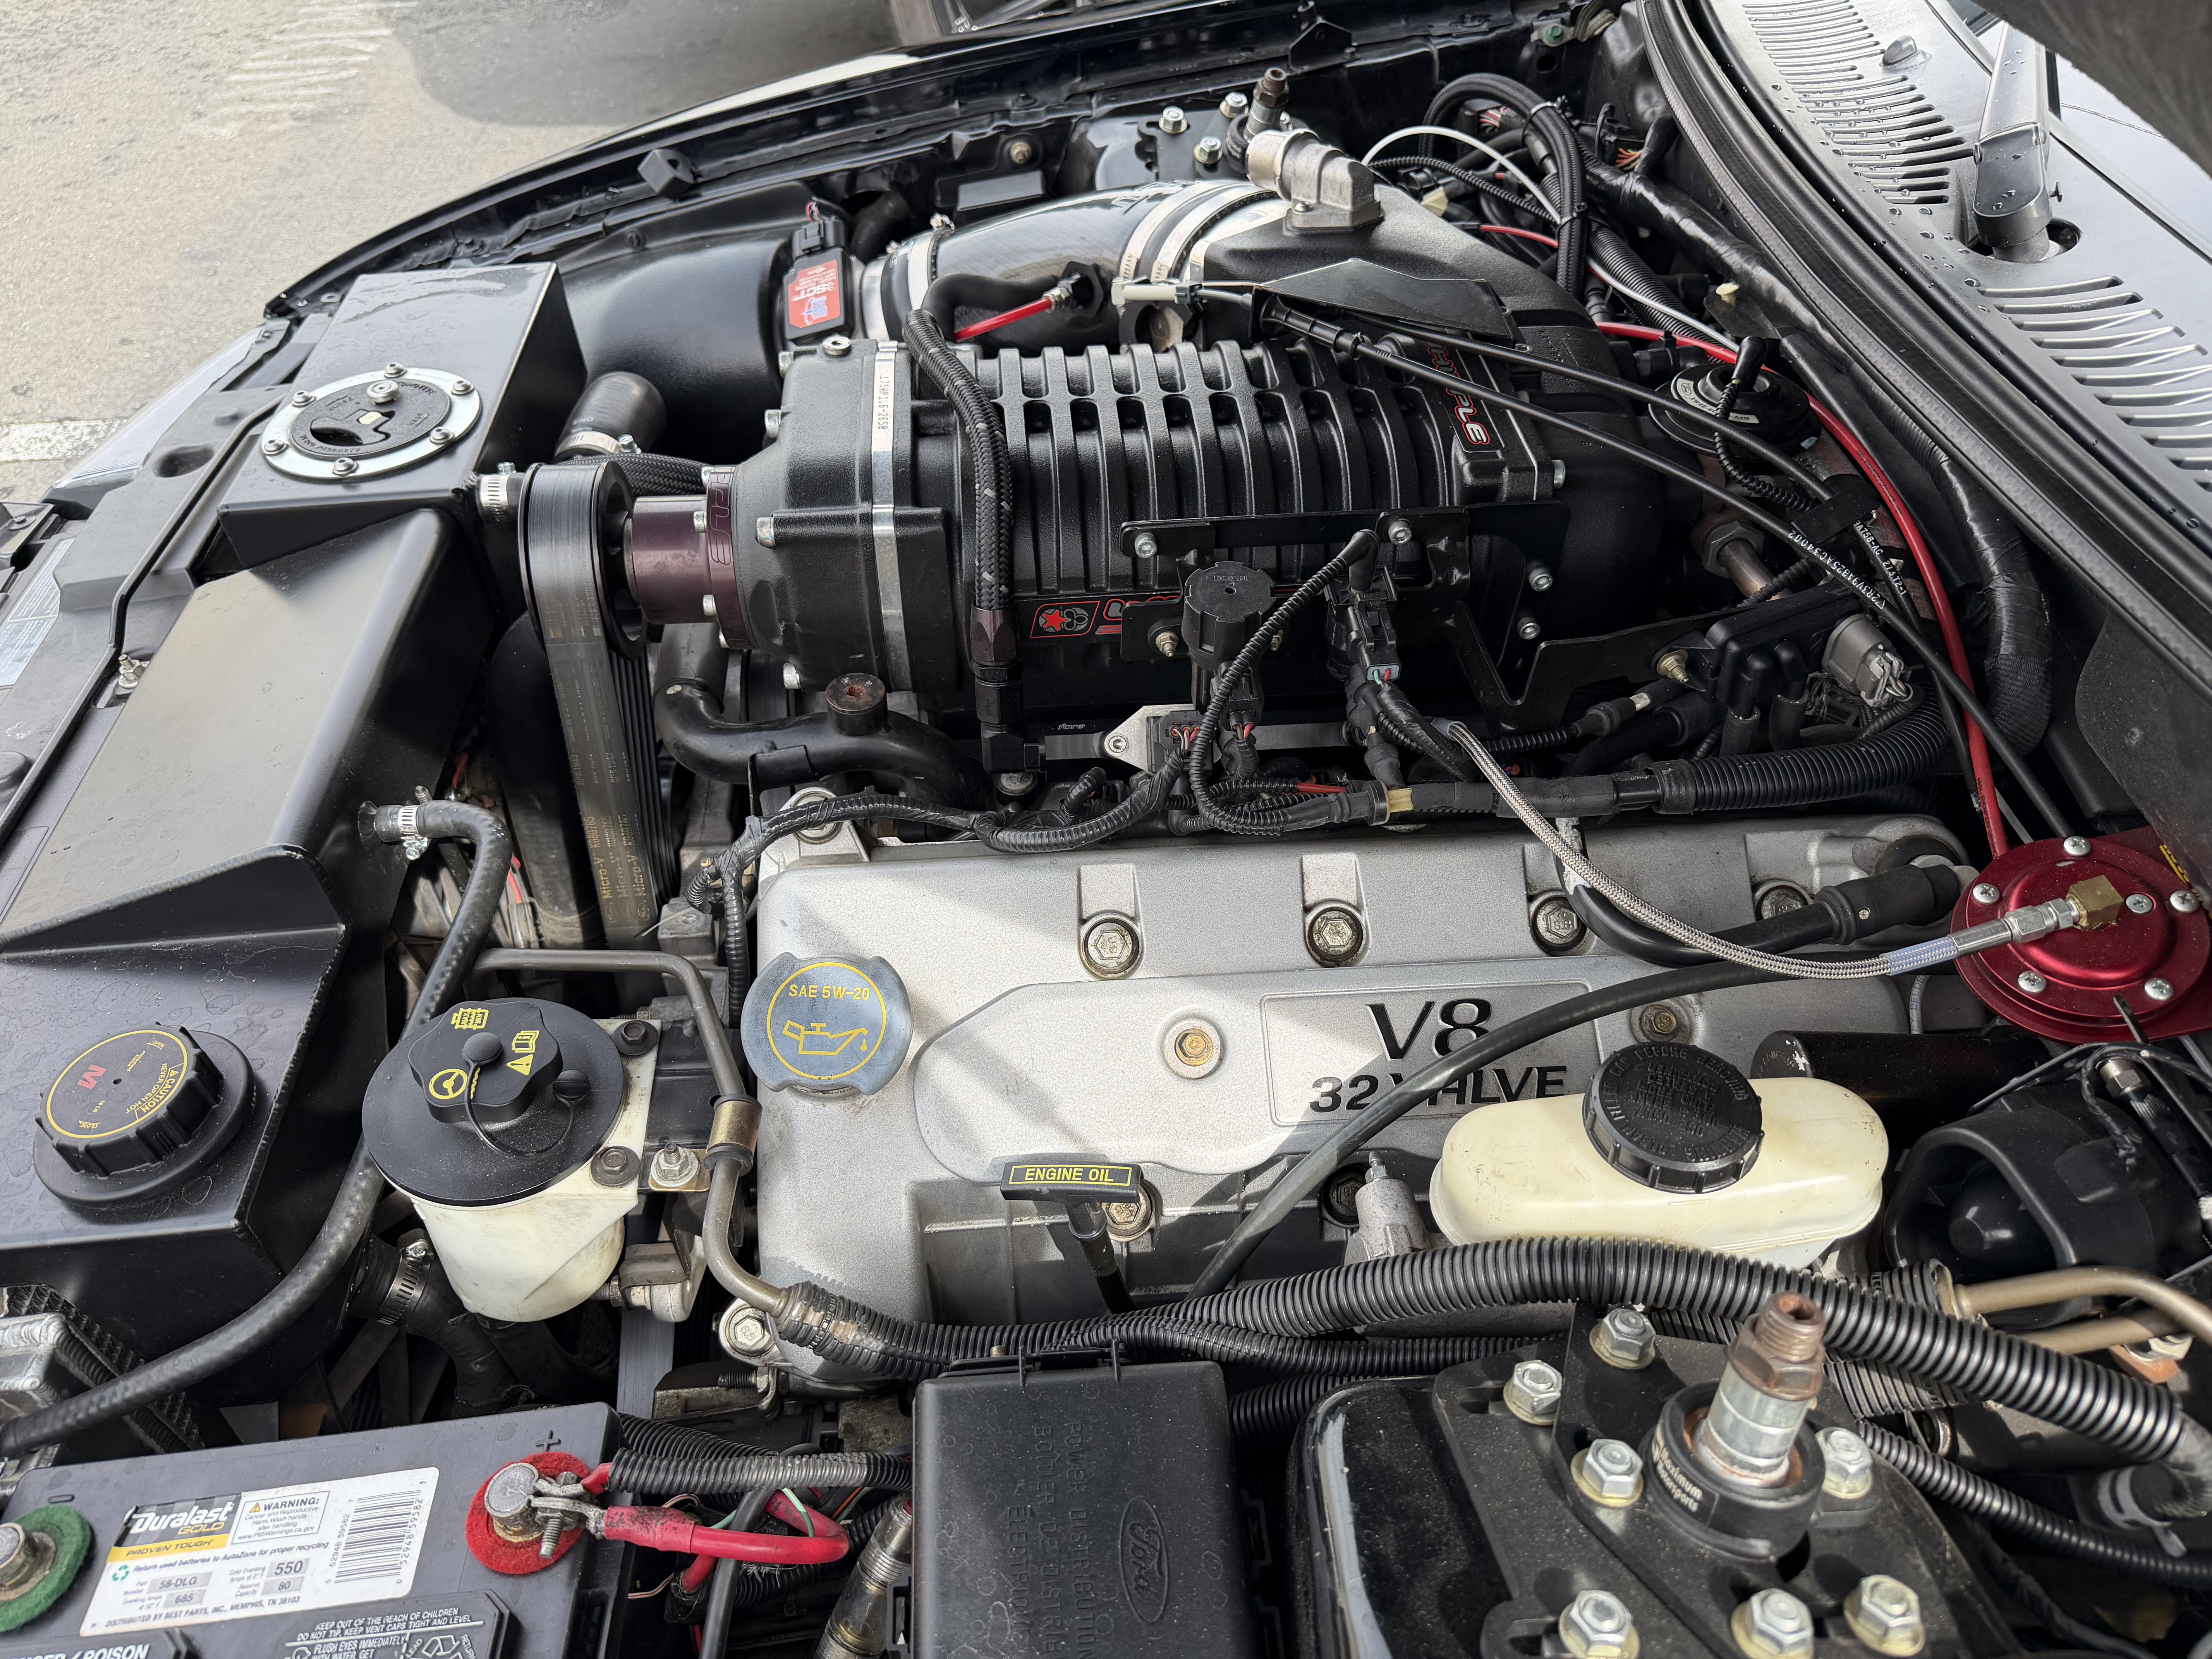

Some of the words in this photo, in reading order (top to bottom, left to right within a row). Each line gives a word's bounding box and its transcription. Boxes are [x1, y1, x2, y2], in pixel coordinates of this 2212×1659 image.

[594, 855, 613, 899] Micro-V
[789, 984, 818, 998] SAE
[822, 986, 871, 1000] 5W-20
[474, 1014, 483, 1024] MIN
[1365, 998, 1492, 1060] V8
[156, 1063, 168, 1083] NEVER
[141, 1078, 175, 1113] CAUTION
[142, 1084, 160, 1101] OPEN
[1309, 1072, 1379, 1112] 32
[126, 1101, 142, 1113] HOT
[1025, 1168, 1083, 1181] ENGINE
[1089, 1168, 1114, 1182] OIL
[1064, 1422, 1084, 1493] POWER
[1660, 1447, 1703, 1501] Maximum
[1657, 1459, 1699, 1513] Motorsports
[264, 1498, 319, 1511] WARNING:
[280, 1506, 318, 1515] Reproductive
[130, 1502, 234, 1534] Duralast
[178, 1522, 225, 1535] GOLD
[399, 1534, 414, 1565] 52948
[409, 1498, 423, 1529] 59582
[1039, 1522, 1058, 1548] DE
[125, 1545, 171, 1557] PROVEN
[175, 1539, 213, 1549] TOUGH
[329, 1541, 342, 1567] 52948
[337, 1513, 350, 1539] 59582
[133, 1563, 158, 1572] Return
[178, 1557, 210, 1566] batteries
[221, 1551, 257, 1561] AutoZone
[269, 1546, 295, 1556] proper
[296, 1542, 329, 1552] recycling
[1129, 1523, 1163, 1595] Ford
[275, 1560, 303, 1575] 550
[159, 1576, 198, 1589] 58-DLG
[278, 1581, 291, 1590] 80
[278, 1595, 301, 1605] 38103
[297, 1632, 309, 1641] DO
[310, 1630, 327, 1640] NOT
[329, 1629, 342, 1637] TIP.
[344, 1626, 364, 1636] KEEP
[366, 1624, 385, 1633] VENT
[386, 1621, 407, 1631] CAPS
[409, 1619, 431, 1628] TIGHT
[432, 1617, 448, 1626] AND
[449, 1614, 472, 1624] LEVEL
[315, 1621, 335, 1631] KEEP
[336, 1620, 353, 1629] OUT
[354, 1618, 366, 1626] OF
[367, 1616, 382, 1625] THE
[383, 1614, 409, 1623] REACH
[409, 1612, 421, 1620] OF
[422, 1607, 459, 1619] CHILDREN
[313, 1643, 338, 1654] FLUSH
[338, 1640, 358, 1651] EYES
[359, 1635, 407, 1649] IMMEDIATELY
[359, 1649, 375, 1659] GET
[407, 1638, 423, 1659] LEAD
